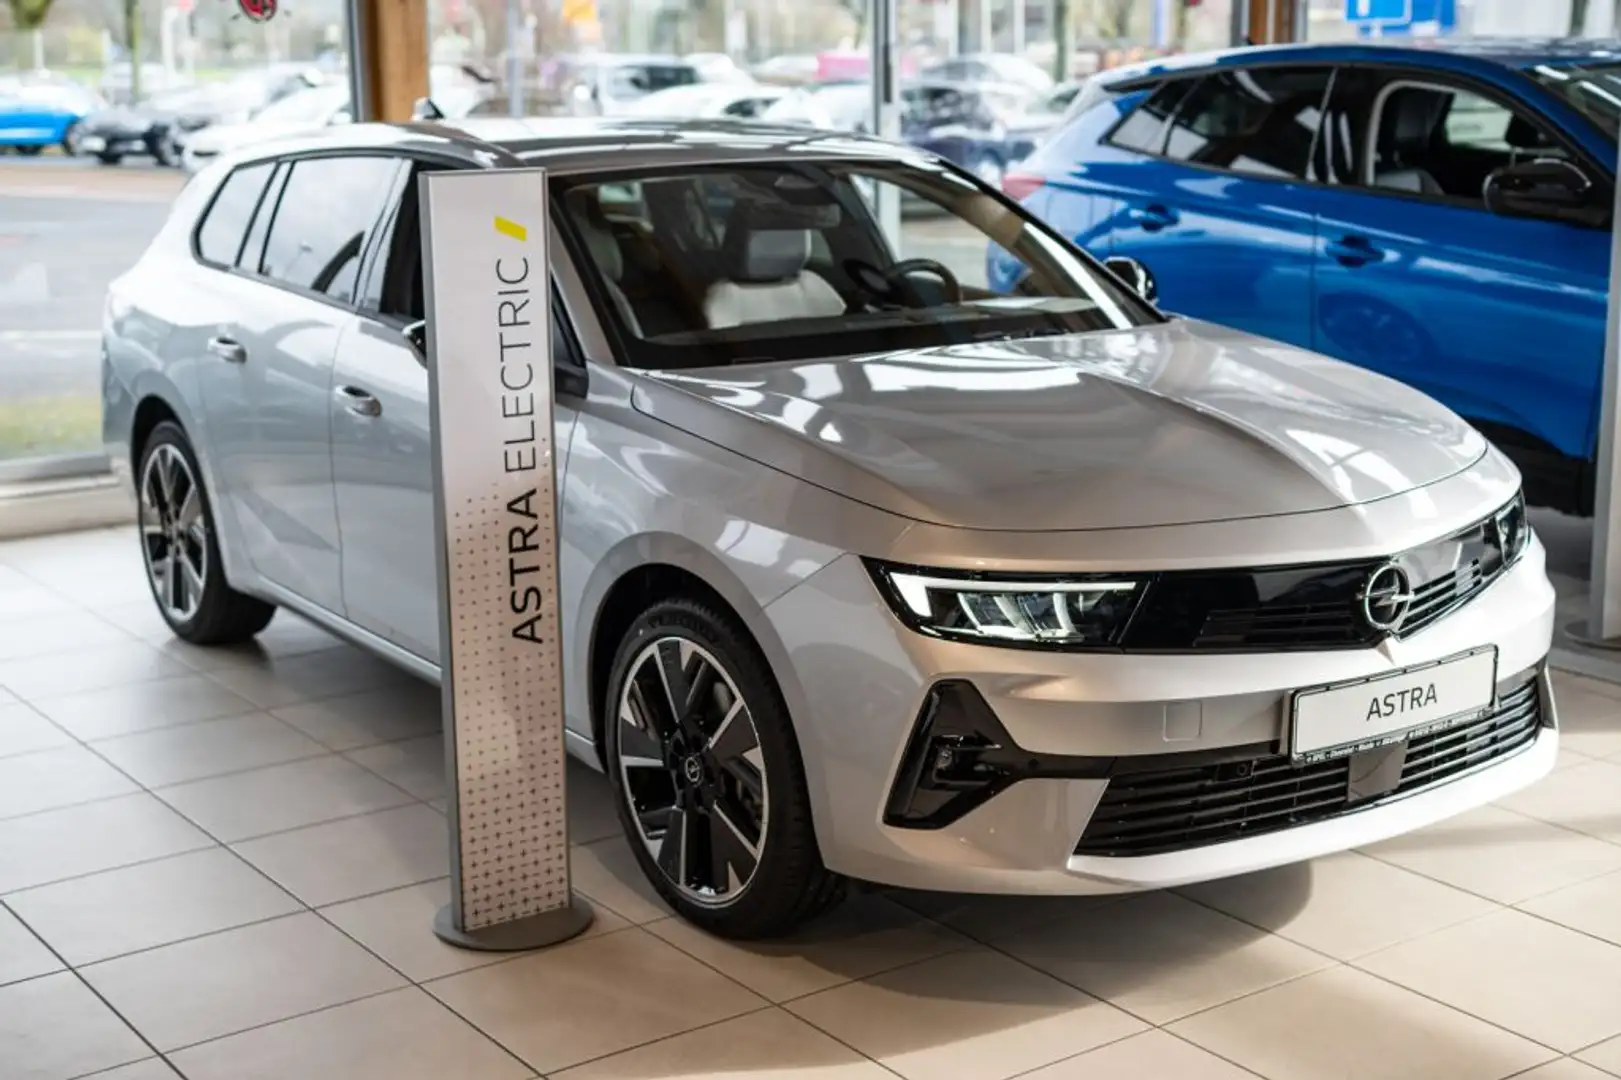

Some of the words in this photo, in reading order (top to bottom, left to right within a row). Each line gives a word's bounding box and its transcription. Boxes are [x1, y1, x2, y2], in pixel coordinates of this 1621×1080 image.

[496, 257, 537, 474] ELECTRIC
[507, 488, 544, 644] ASTRA
[1366, 683, 1437, 722] ASTRA
